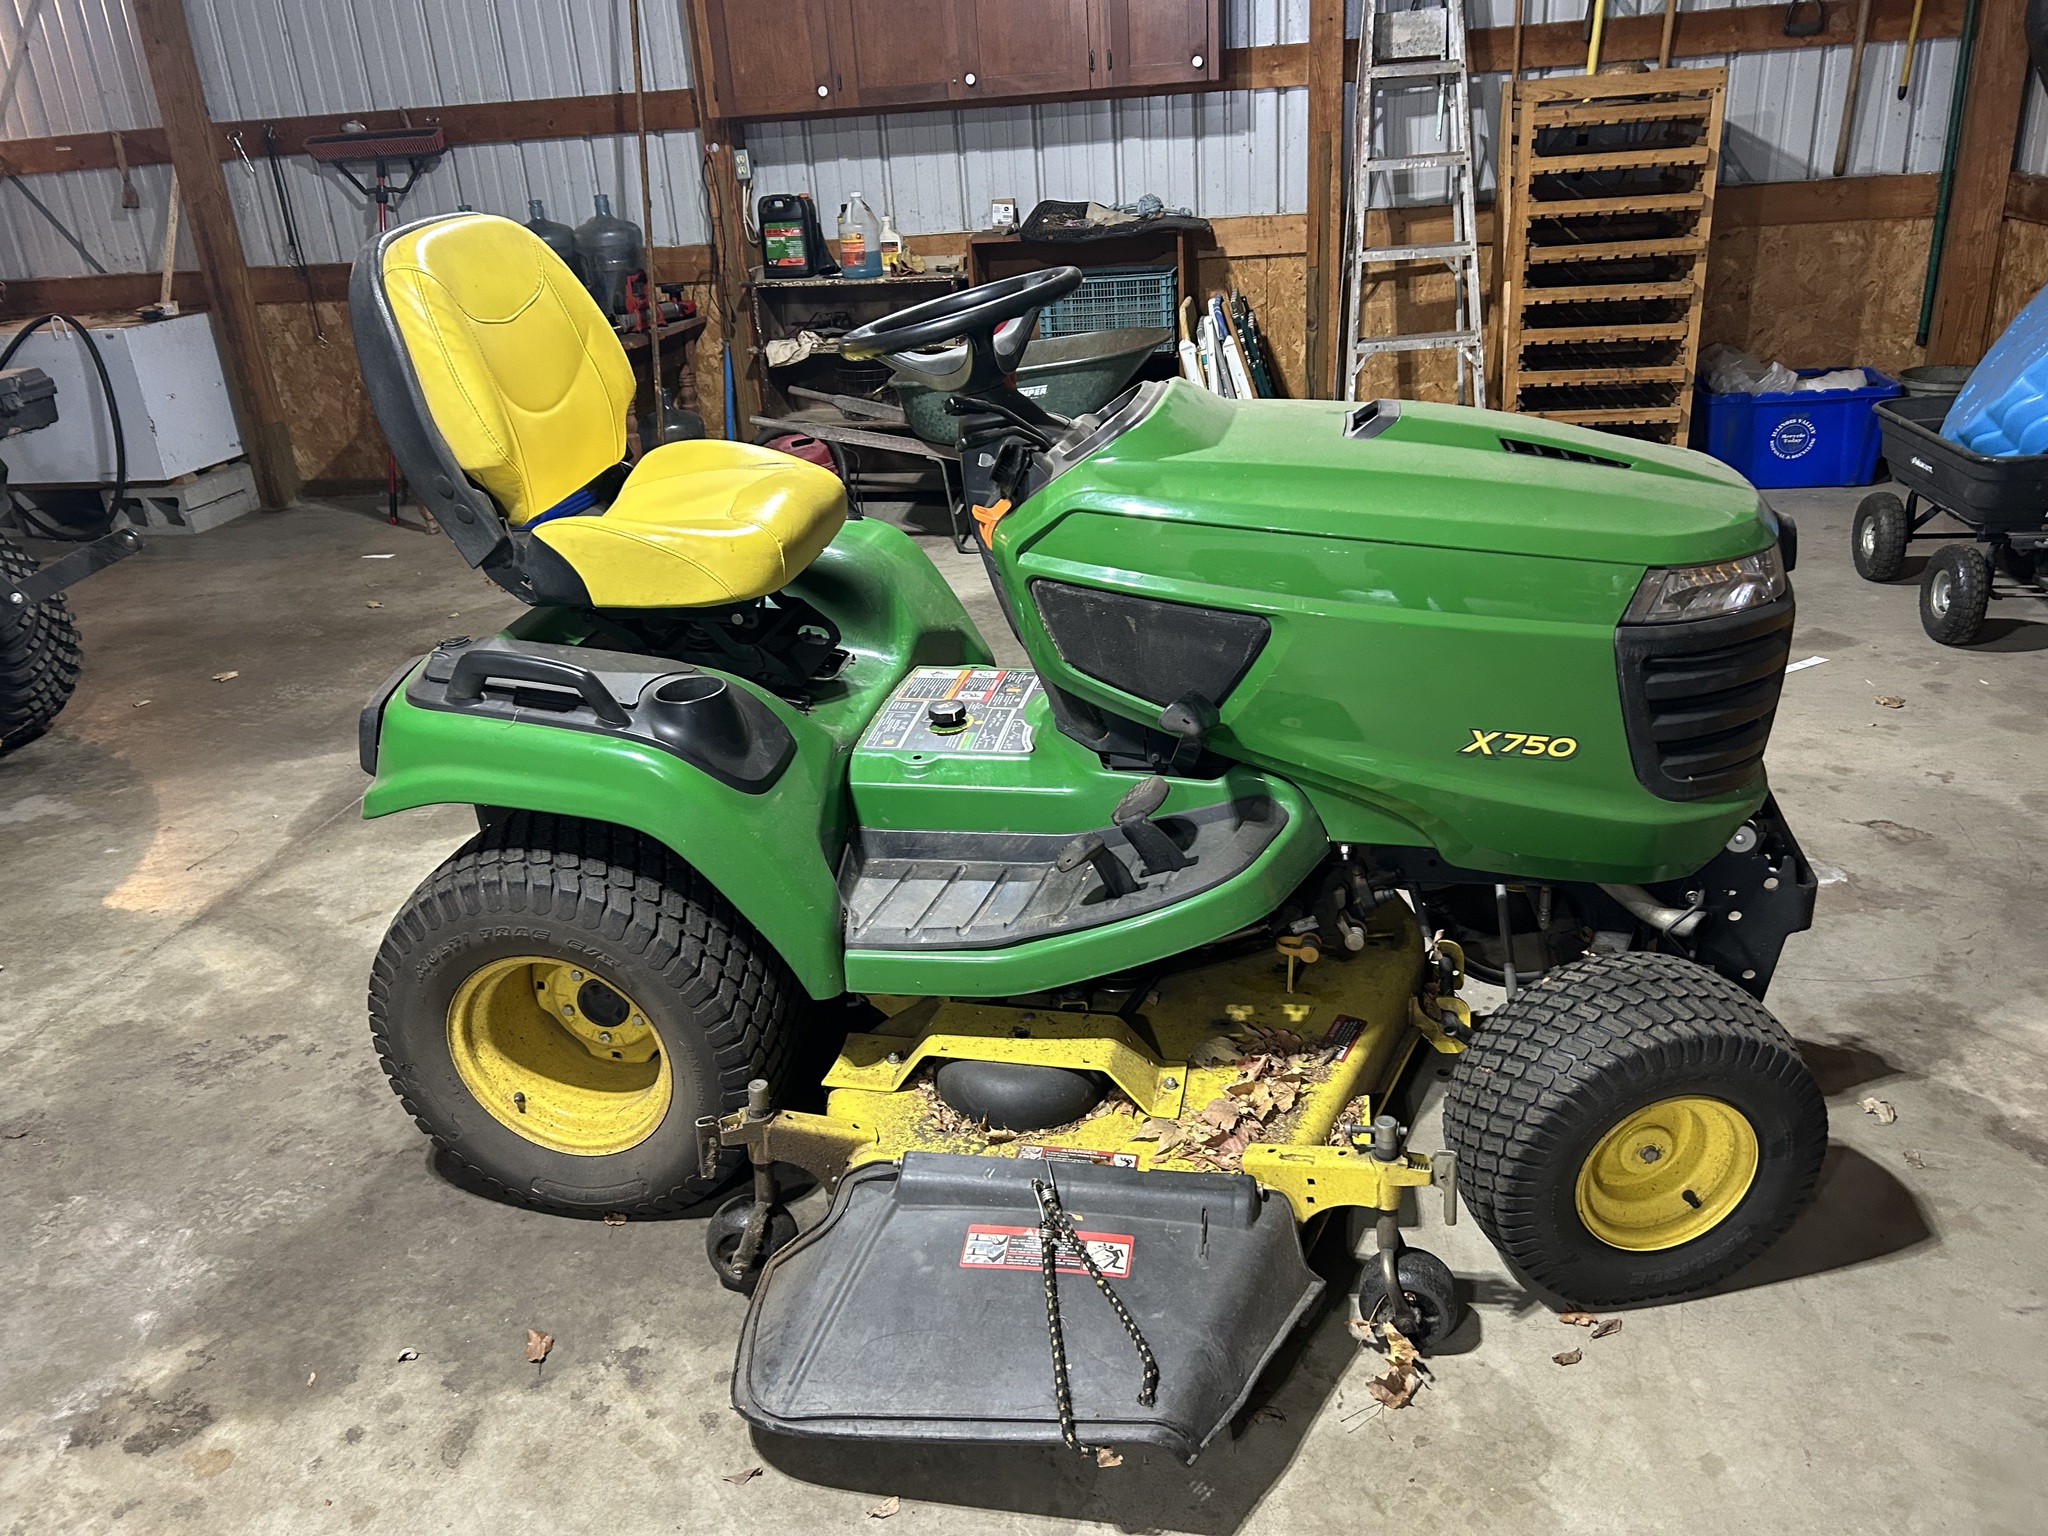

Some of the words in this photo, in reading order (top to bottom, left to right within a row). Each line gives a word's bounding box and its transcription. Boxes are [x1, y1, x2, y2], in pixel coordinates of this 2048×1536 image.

[1771, 418, 1797, 437] ILLINOIS
[1798, 418, 1817, 434] VALLEY
[1459, 729, 1578, 758] X750
[414, 932, 470, 982] MULTI
[478, 926, 551, 940] TRAC
